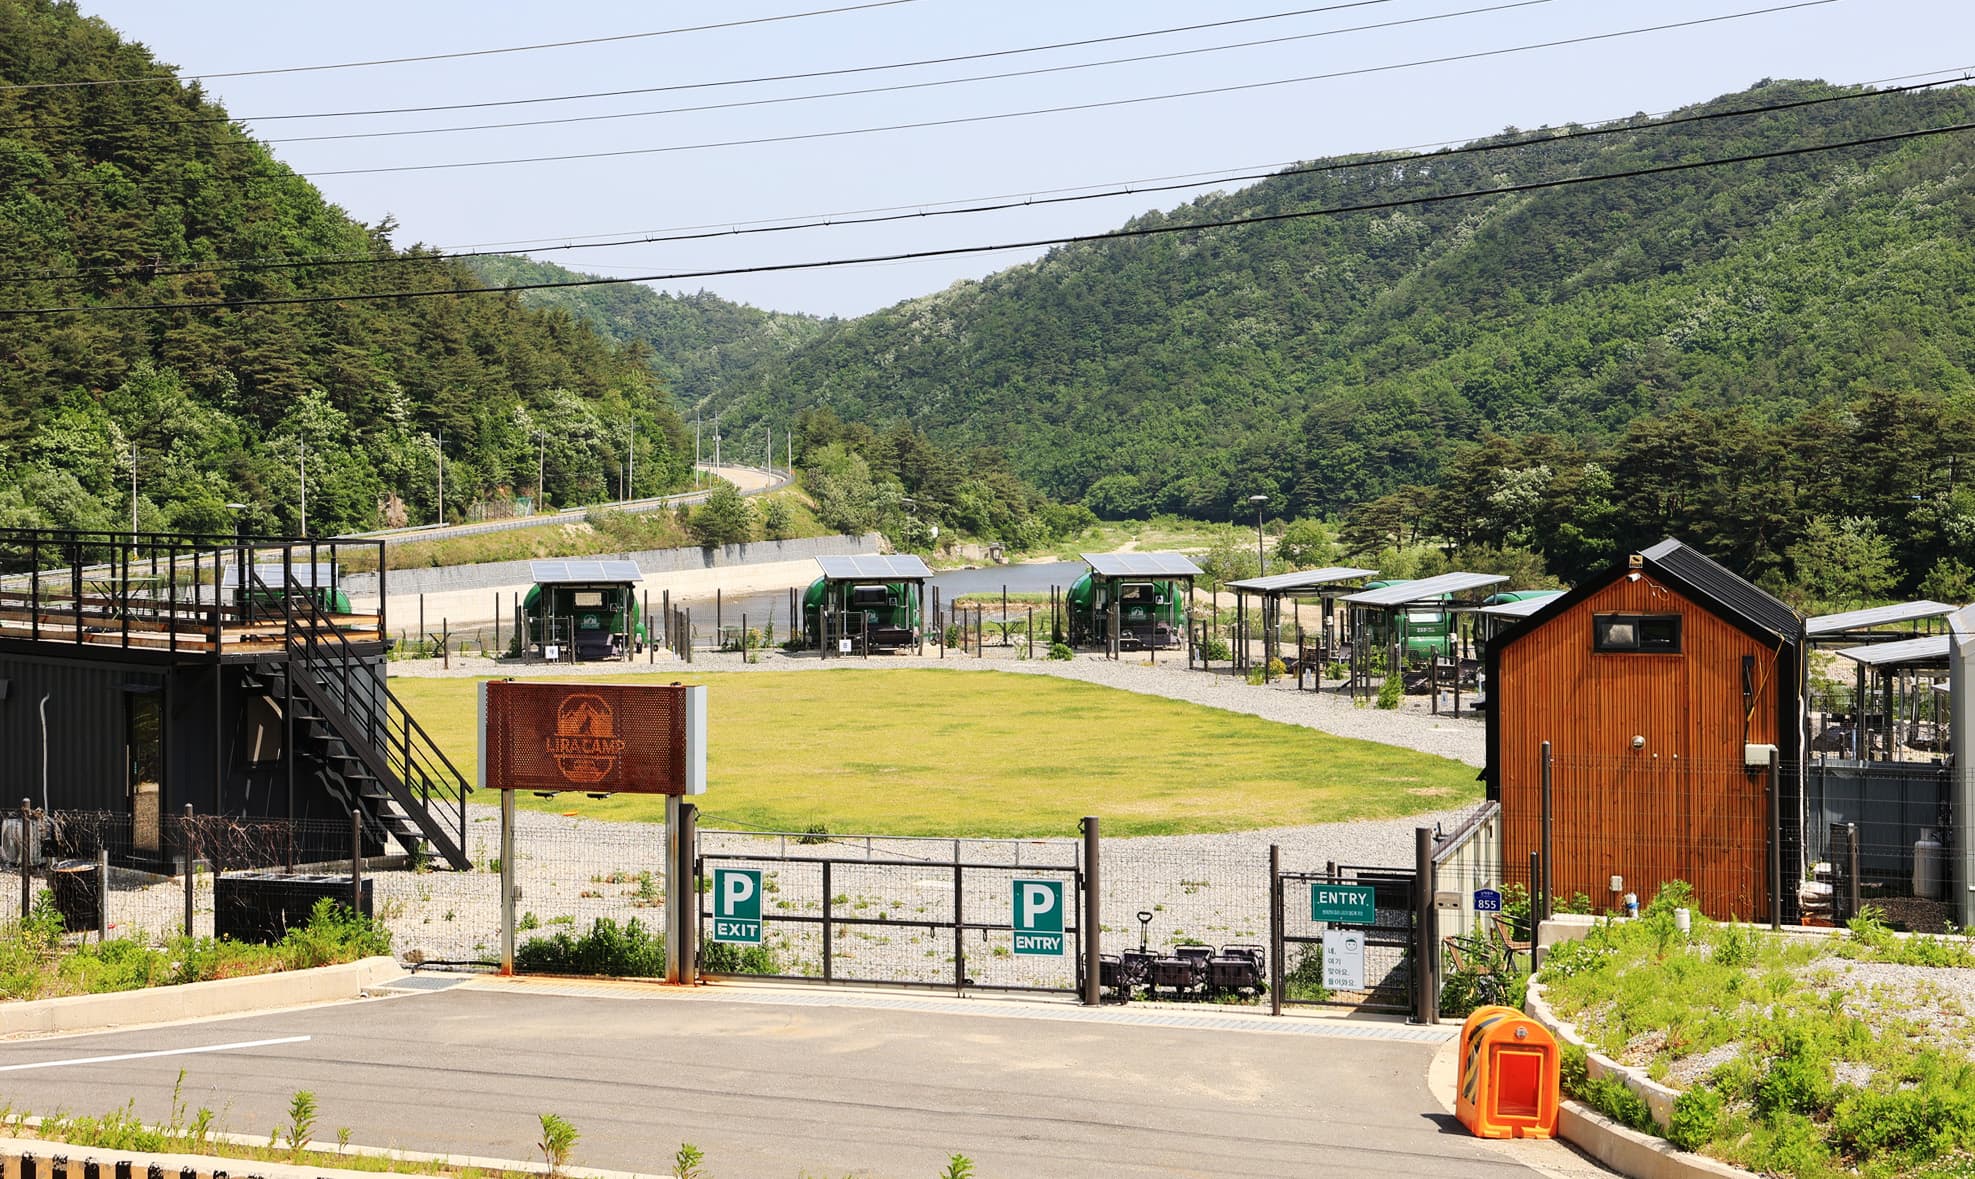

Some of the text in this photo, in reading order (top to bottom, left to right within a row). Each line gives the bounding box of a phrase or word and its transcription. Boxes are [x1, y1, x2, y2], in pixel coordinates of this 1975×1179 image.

[546, 738, 625, 754] LIRA CAMP
[724, 872, 754, 916] P
[1319, 891, 1367, 905] ENTRY
[1023, 884, 1055, 928] P
[1478, 899, 1497, 910] 855
[717, 922, 759, 937] EXIT
[1015, 935, 1061, 950] ENTRY
